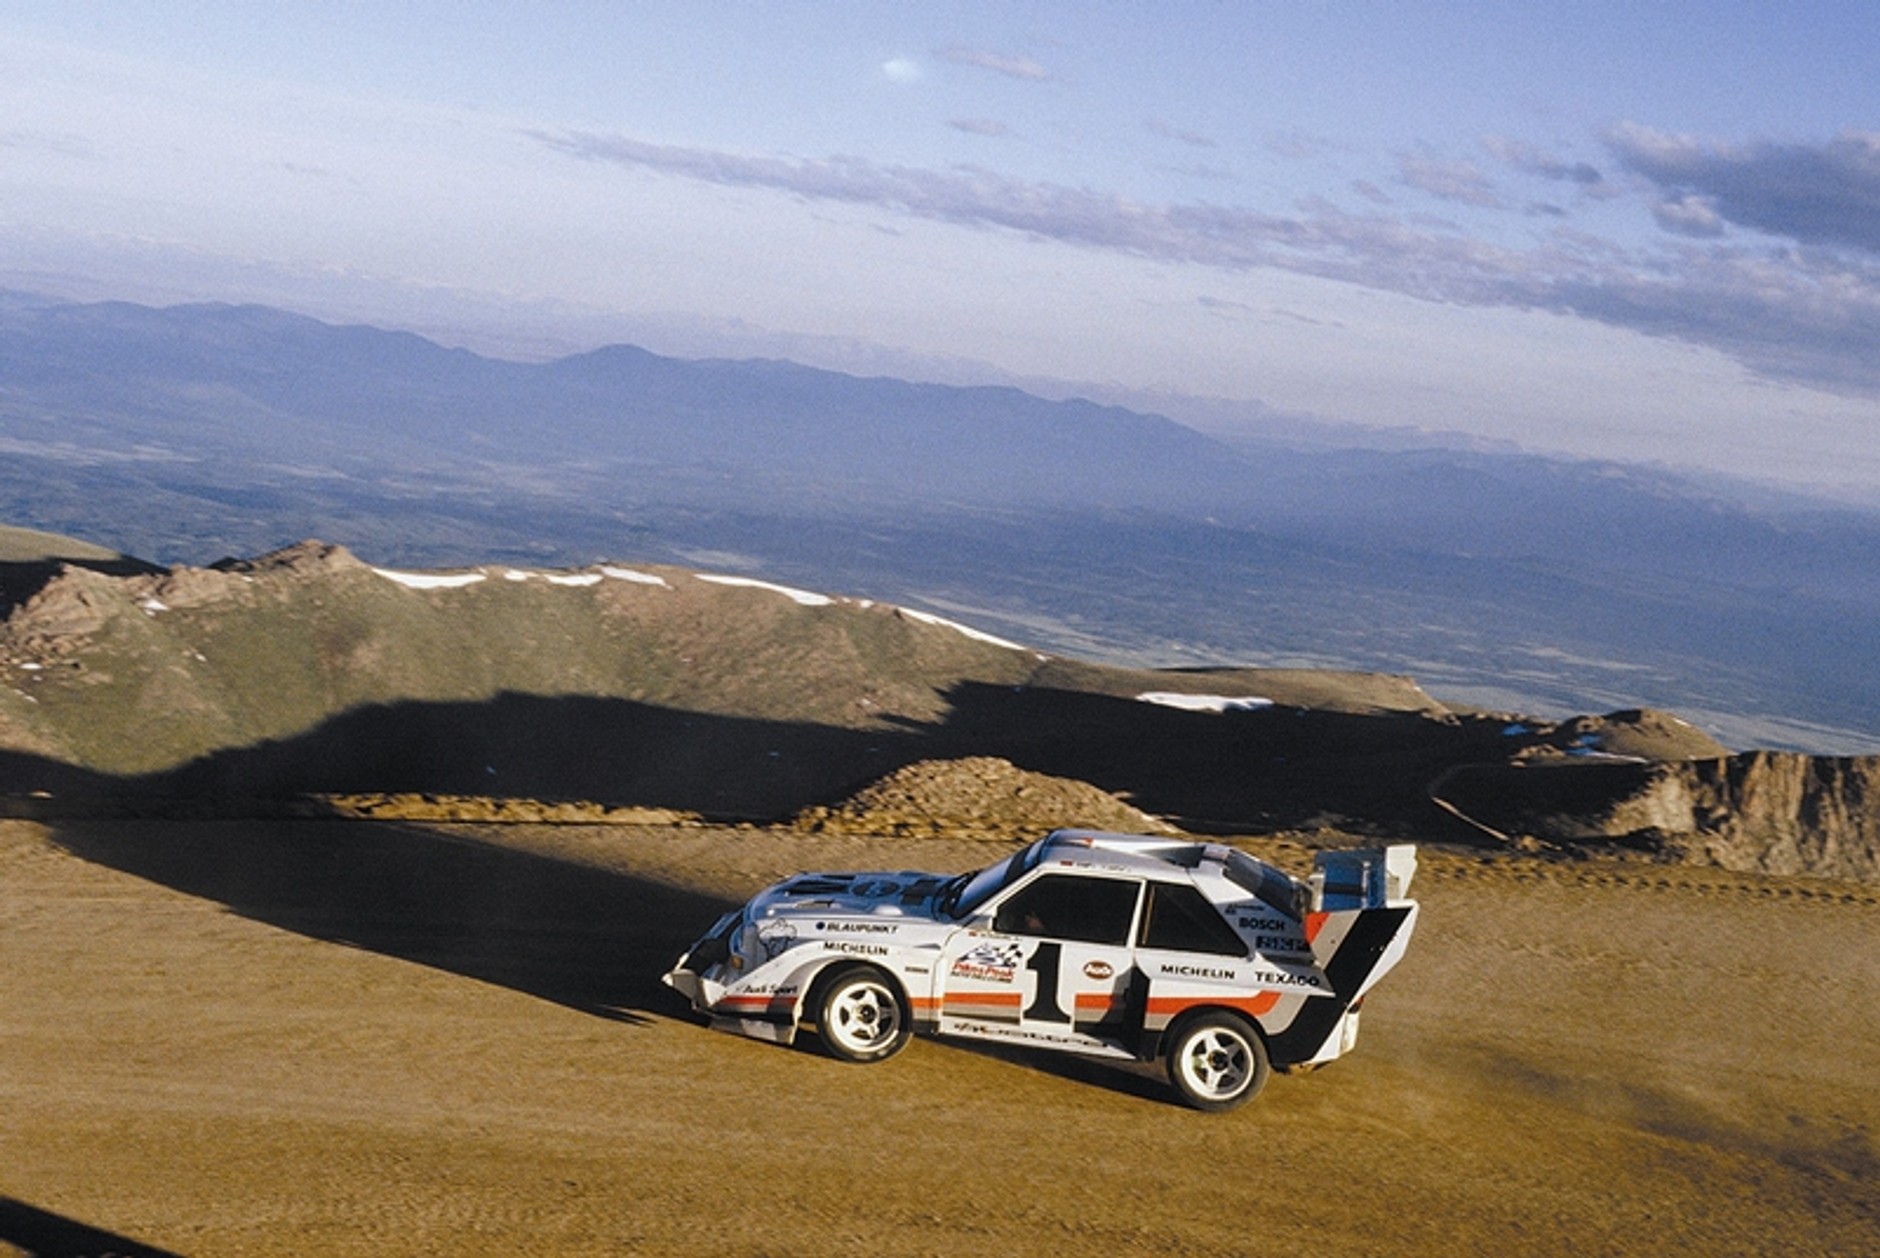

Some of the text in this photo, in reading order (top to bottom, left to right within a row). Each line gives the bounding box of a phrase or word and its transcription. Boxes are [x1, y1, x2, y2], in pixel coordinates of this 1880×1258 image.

[827, 923, 898, 933] BLAUPUNKT
[1239, 917, 1285, 930] BOSCH
[823, 941, 888, 955] MICHELIN
[1160, 964, 1236, 980] MICHELIN
[1023, 941, 1071, 1023] 1
